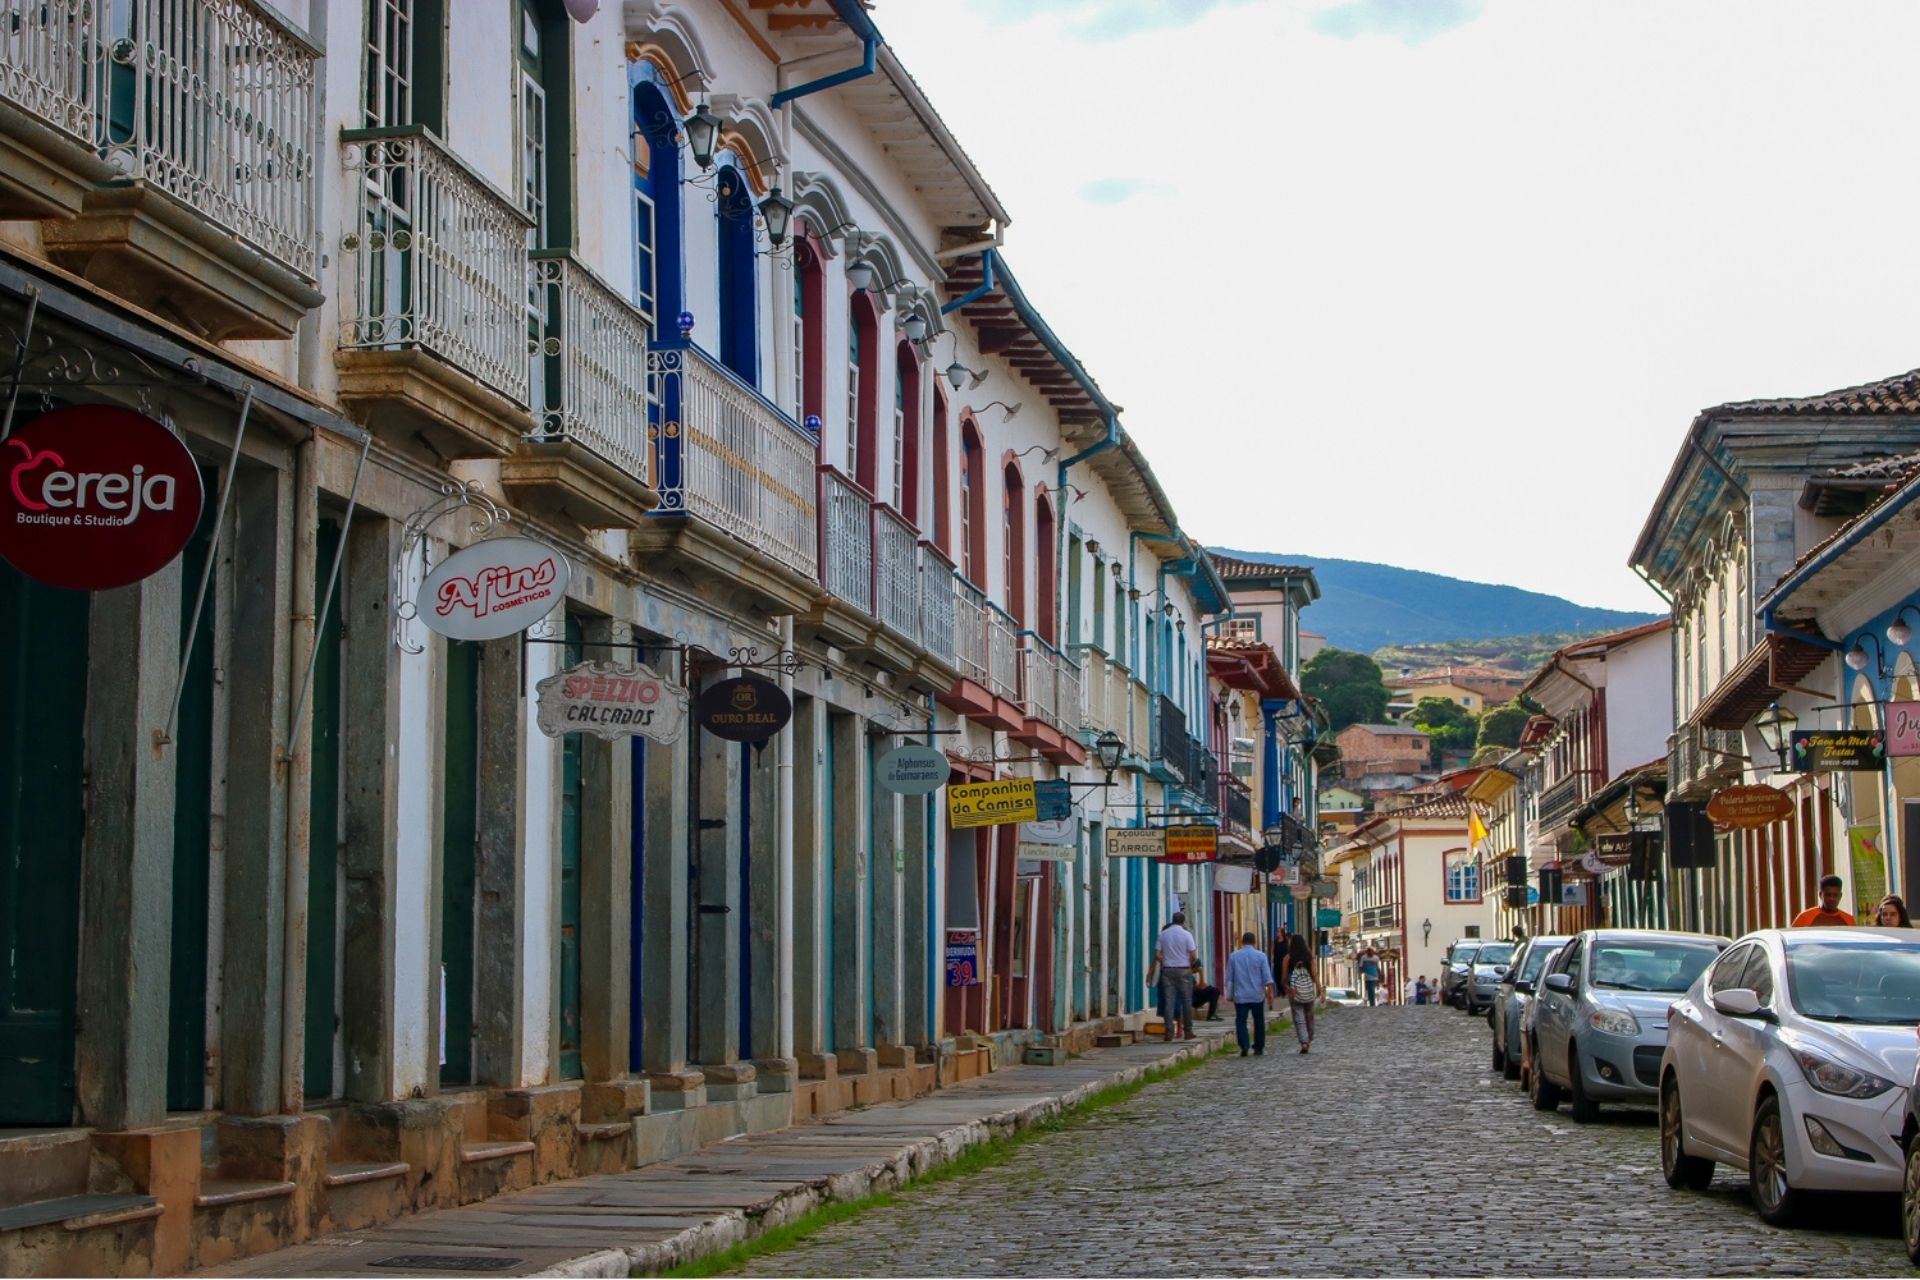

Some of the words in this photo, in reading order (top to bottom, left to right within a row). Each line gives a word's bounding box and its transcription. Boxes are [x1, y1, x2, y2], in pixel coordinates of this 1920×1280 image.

[10, 447, 176, 525] Cereja
[17, 512, 71, 527] Boutique
[73, 515, 82, 525] &
[84, 514, 124, 527] Studio
[436, 558, 556, 619] Afins
[567, 705, 655, 726] CALÇADOS
[711, 713, 745, 724] OURO
[746, 713, 777, 724] REAL
[1835, 736, 1847, 746] de
[1848, 735, 1870, 747] Mel
[1823, 746, 1856, 758] Festas
[897, 757, 936, 771] Alphonsus
[951, 780, 1032, 799] Companhia
[952, 802, 971, 814] da
[976, 797, 1033, 811] Camisa
[1116, 830, 1157, 839] AÇOUGUE
[1109, 838, 1163, 854] BARROCA
[952, 960, 973, 986] 39
